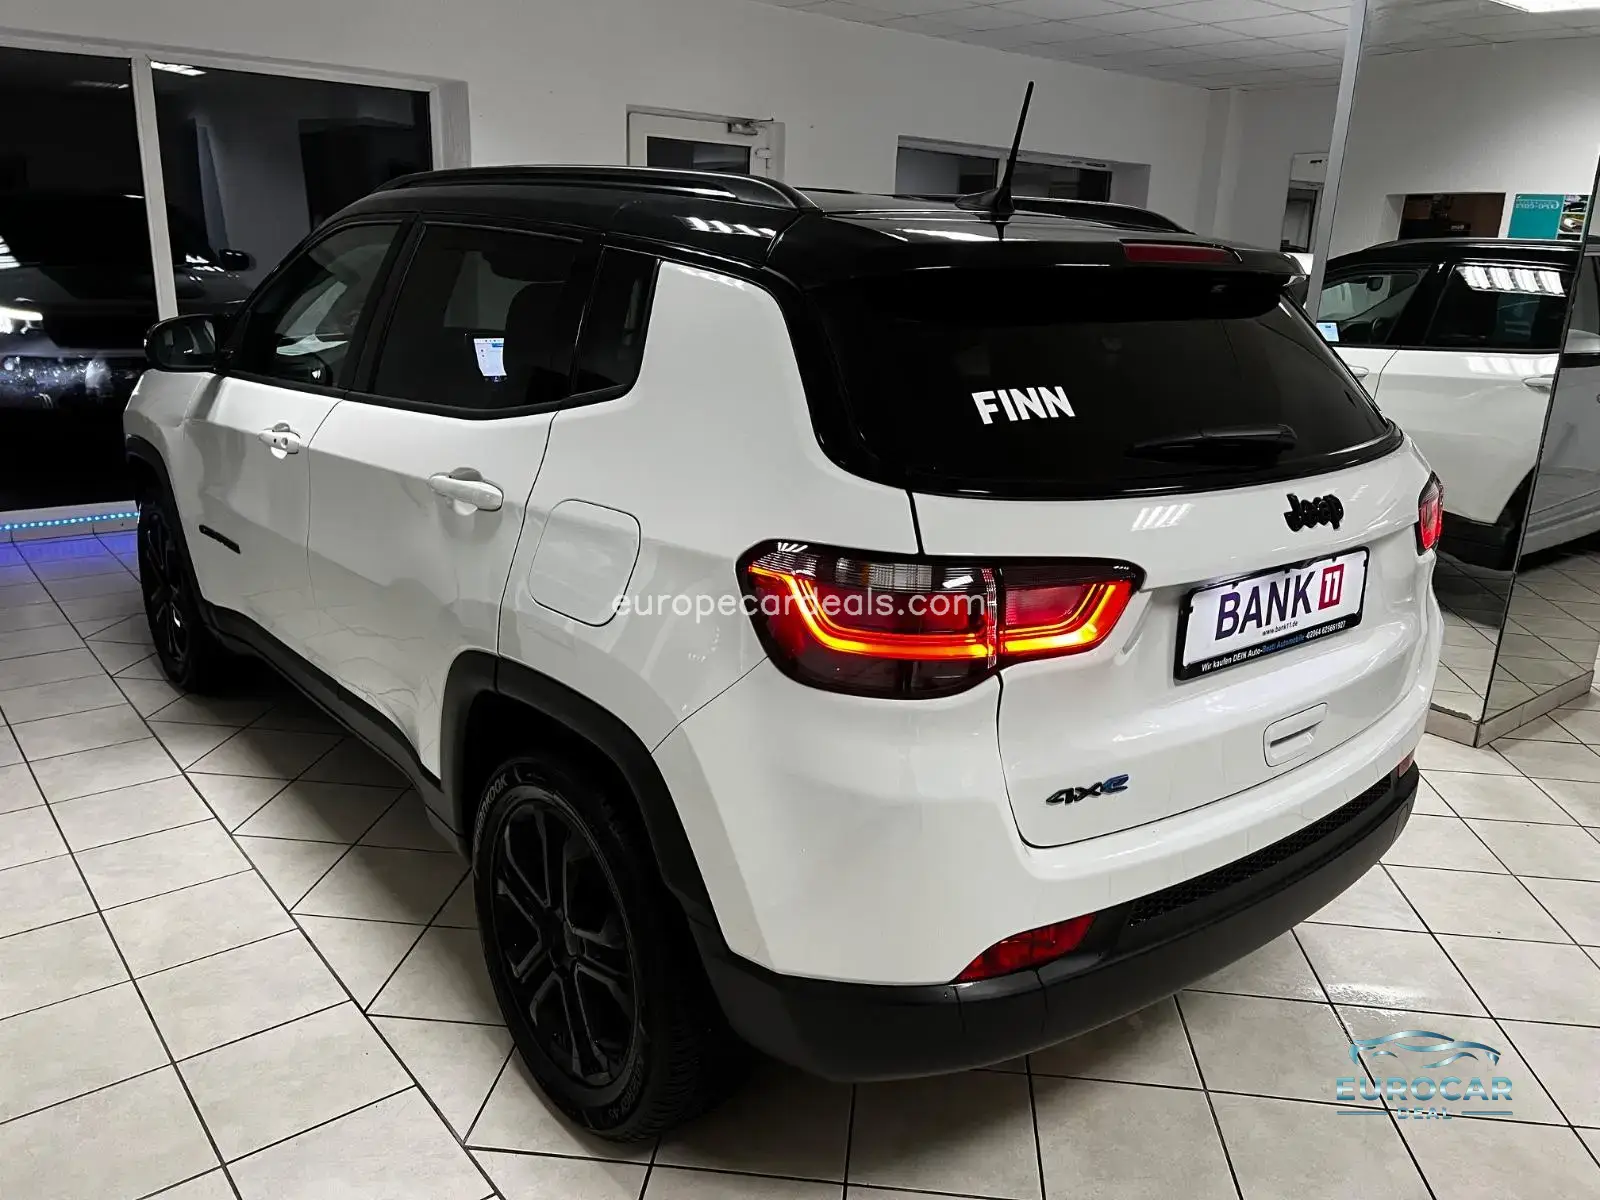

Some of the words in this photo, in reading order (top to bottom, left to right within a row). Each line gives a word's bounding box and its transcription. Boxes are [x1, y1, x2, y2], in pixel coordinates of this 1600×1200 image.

[971, 386, 1076, 425] FINN
[1283, 493, 1344, 532] Jeep
[1214, 571, 1316, 641] BANK
[1321, 567, 1342, 607] 11
[1201, 662, 1212, 672] Wir
[1213, 657, 1232, 668] kaufen
[1233, 651, 1247, 662] DEIN
